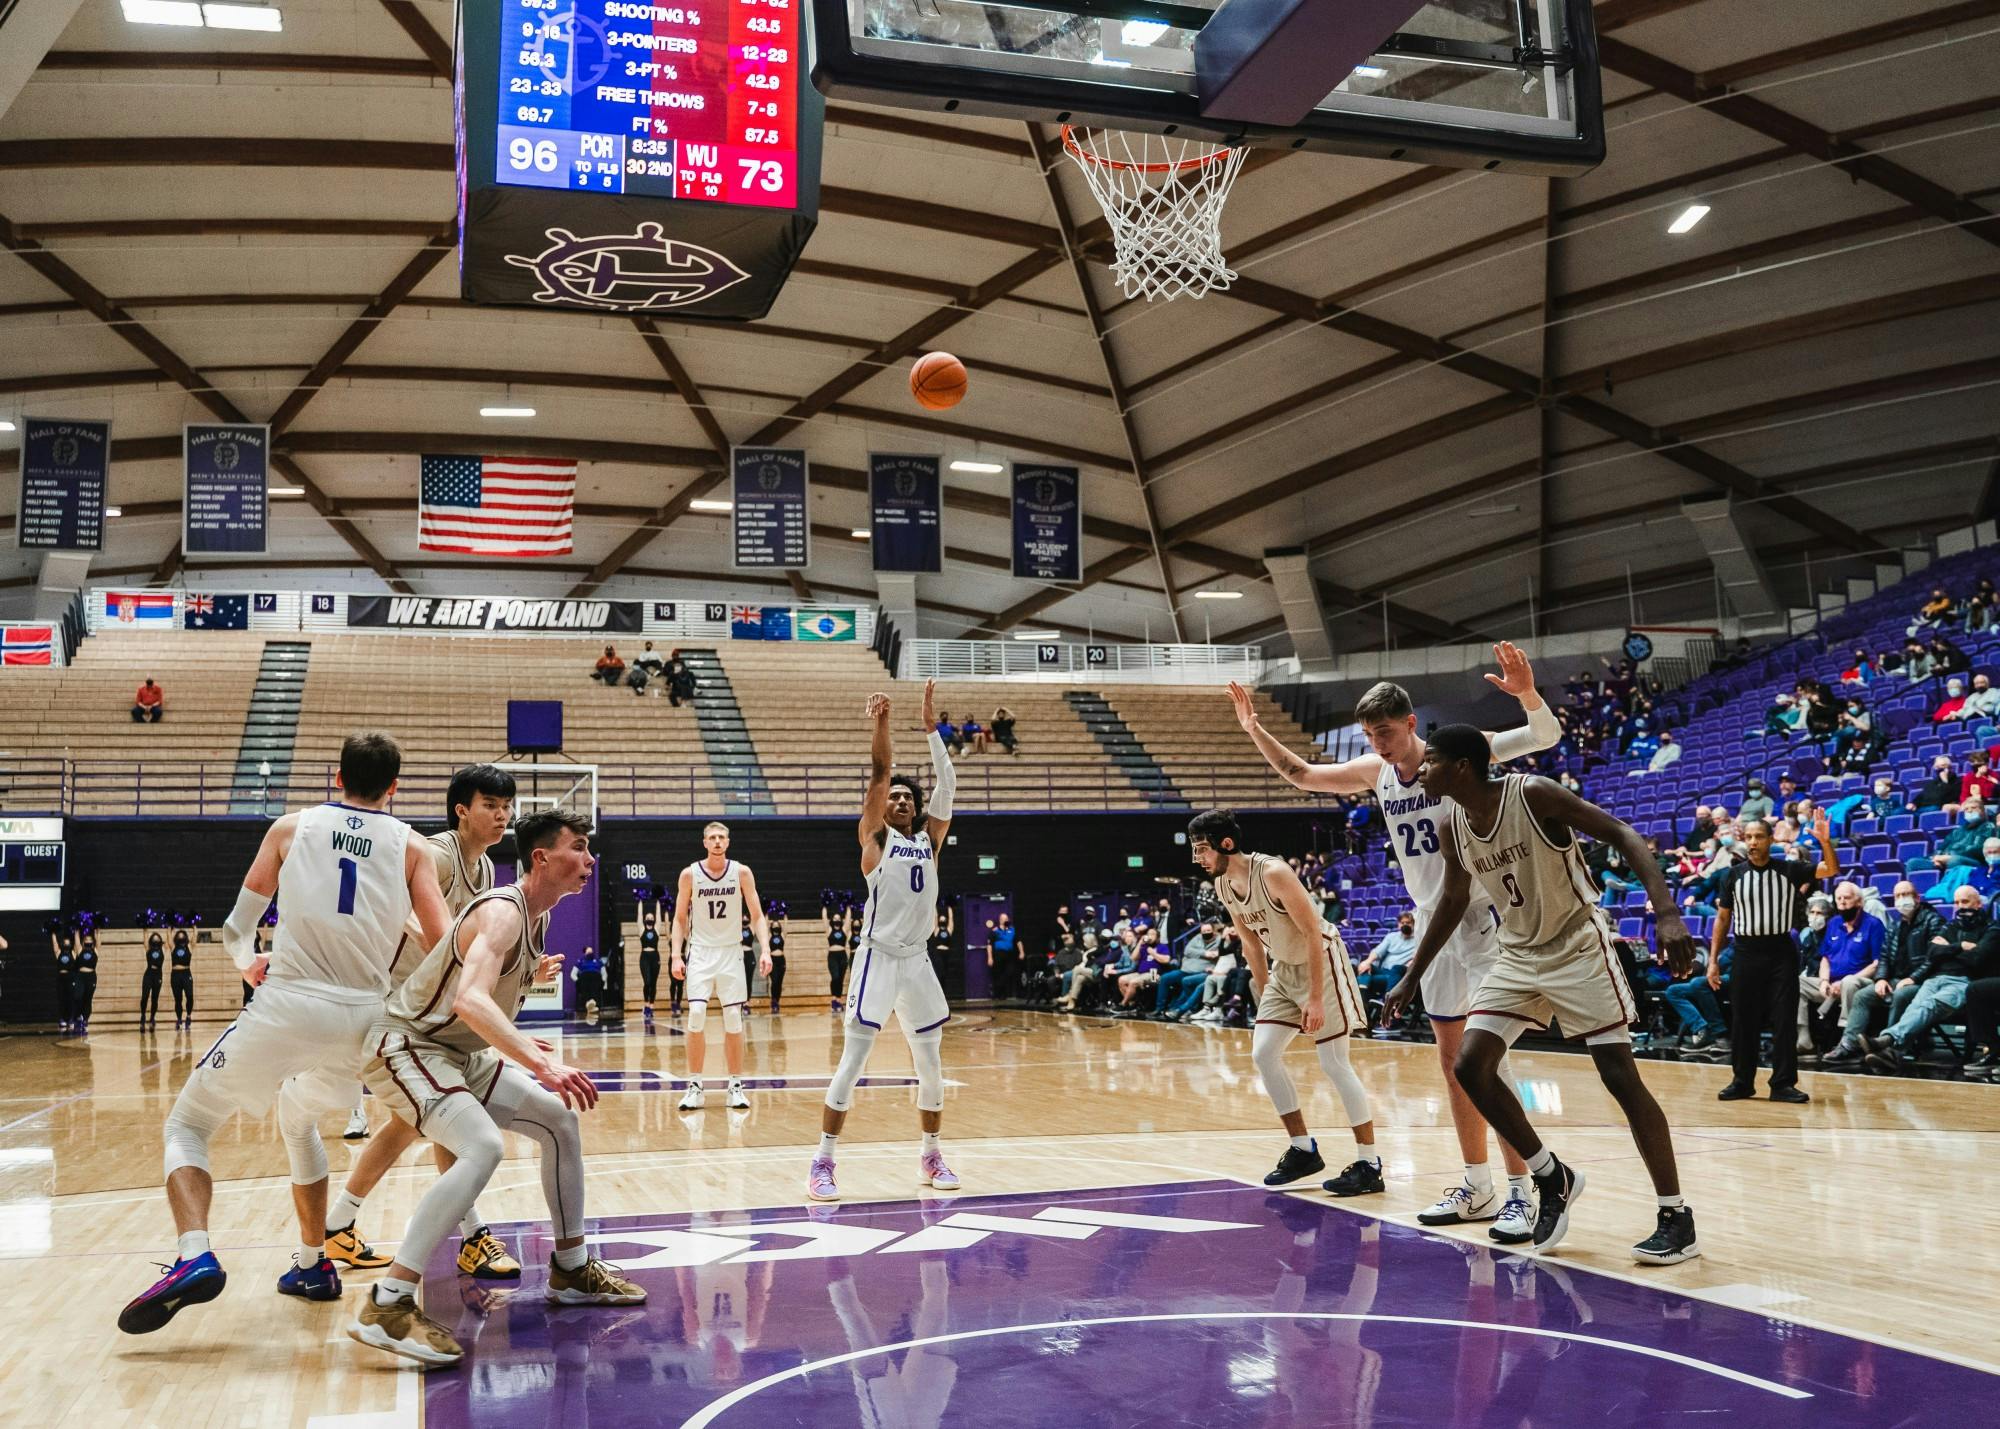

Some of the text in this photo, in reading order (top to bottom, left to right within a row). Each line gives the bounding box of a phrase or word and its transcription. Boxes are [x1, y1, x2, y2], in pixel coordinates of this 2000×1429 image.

[605, 2, 700, 25] SHOOTING %
[747, 18, 780, 33] 43.5
[607, 32, 697, 53] 3-POINTERS
[742, 46, 787, 62] 12-28
[625, 61, 677, 79] 3-PT %
[746, 74, 779, 89] 42.9
[597, 86, 704, 109] FREE THROWS
[632, 117, 668, 134] FT %
[745, 128, 778, 144] 87.5
[580, 134, 613, 158] POR
[632, 139, 667, 155] 8:35
[509, 138, 557, 172] 96
[686, 144, 718, 168] WU
[575, 160, 618, 175] TO FLS
[626, 159, 672, 176] 30 2ND
[738, 159, 784, 192] 73
[578, 174, 587, 185] 3
[680, 169, 722, 184] TO FLS
[684, 184, 718, 196] 1 10
[192, 431, 262, 446] HALL OF FAME
[1038, 543, 1068, 551] STUDENT
[259, 596, 273, 609] 17
[318, 597, 330, 610] 18
[387, 597, 611, 630] WE ARE PORTLAND
[659, 605, 671, 617] 18
[710, 605, 723, 619] 19
[1041, 646, 1056, 661] 19
[1088, 648, 1105, 661] 20
[332, 830, 373, 858] WOOD
[1397, 818, 1440, 857] 23
[24, 845, 59, 857] GUEST
[1472, 841, 1530, 875] WILLAMETTE
[625, 864, 646, 880] 18B
[911, 865, 925, 893] 0
[338, 857, 357, 916] 1
[698, 887, 736, 898] PORTLAND
[1501, 872, 1525, 908] 0
[707, 900, 727, 920] 12
